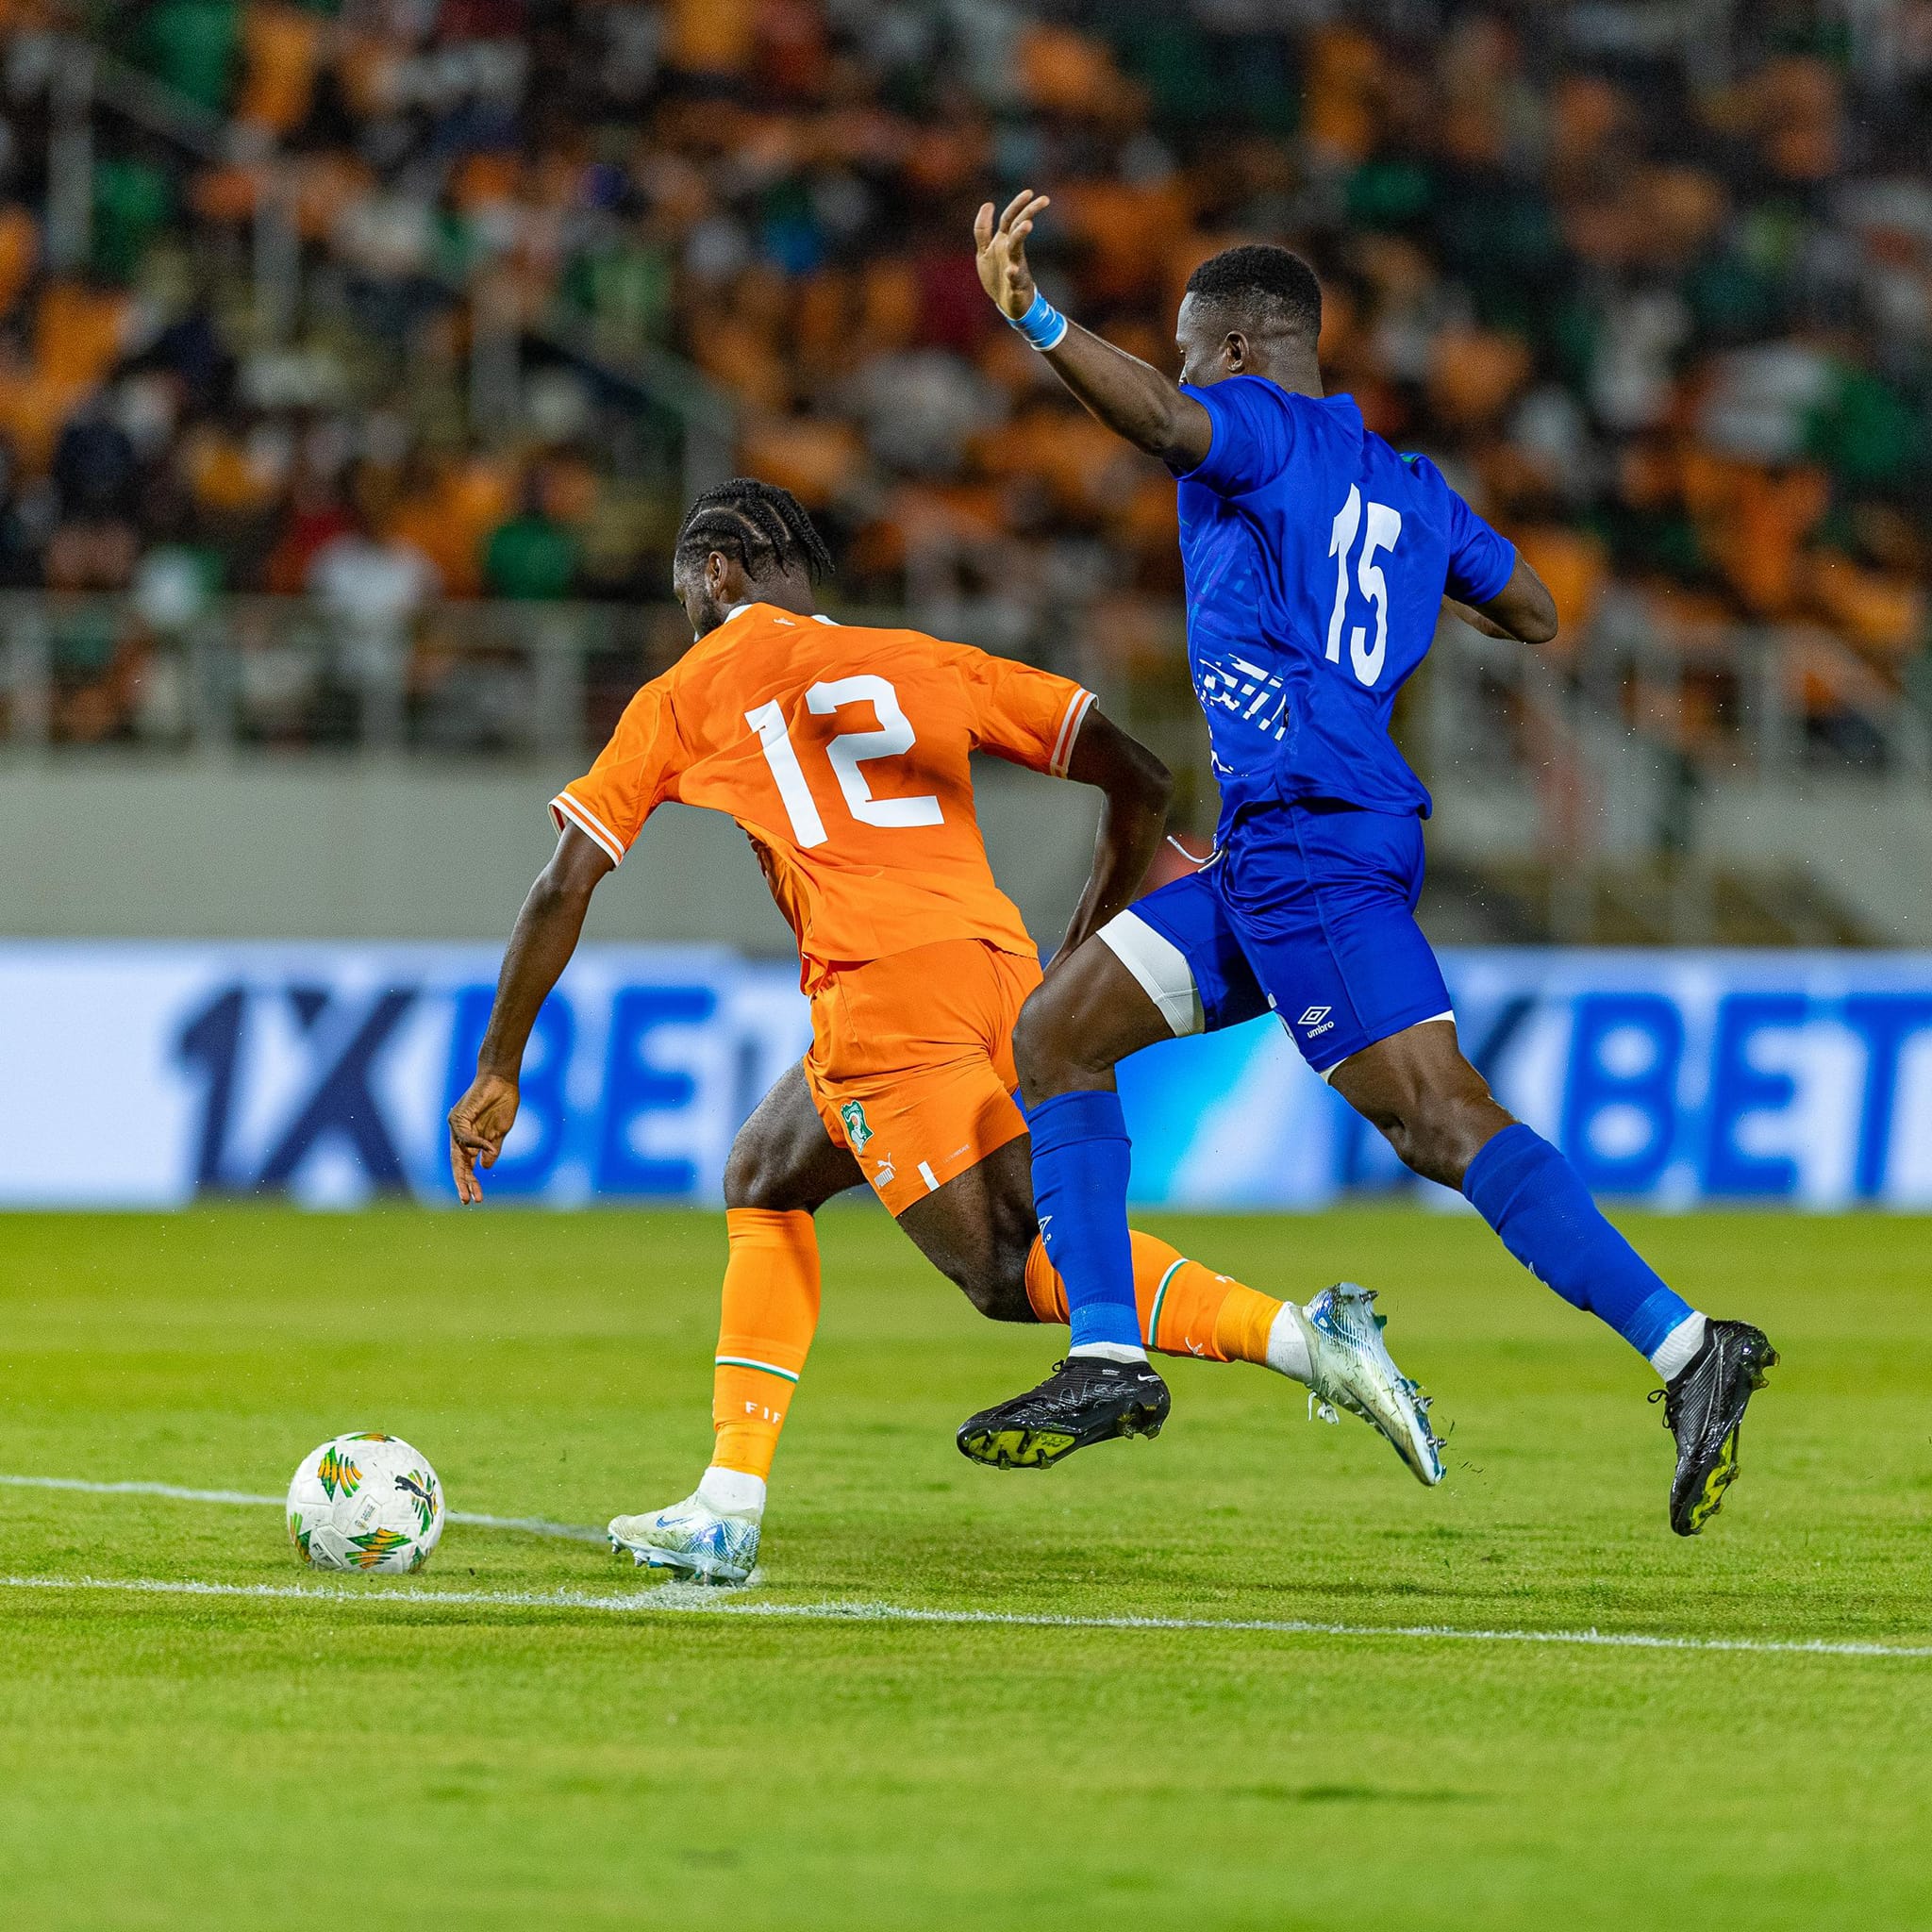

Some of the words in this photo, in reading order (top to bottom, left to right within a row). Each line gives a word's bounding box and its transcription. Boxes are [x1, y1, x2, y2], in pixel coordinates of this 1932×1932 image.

[1325, 482, 1402, 687] 15
[743, 674, 945, 849] 12
[172, 983, 760, 1192] 1XBE
[1307, 1021, 1335, 1039] umbro
